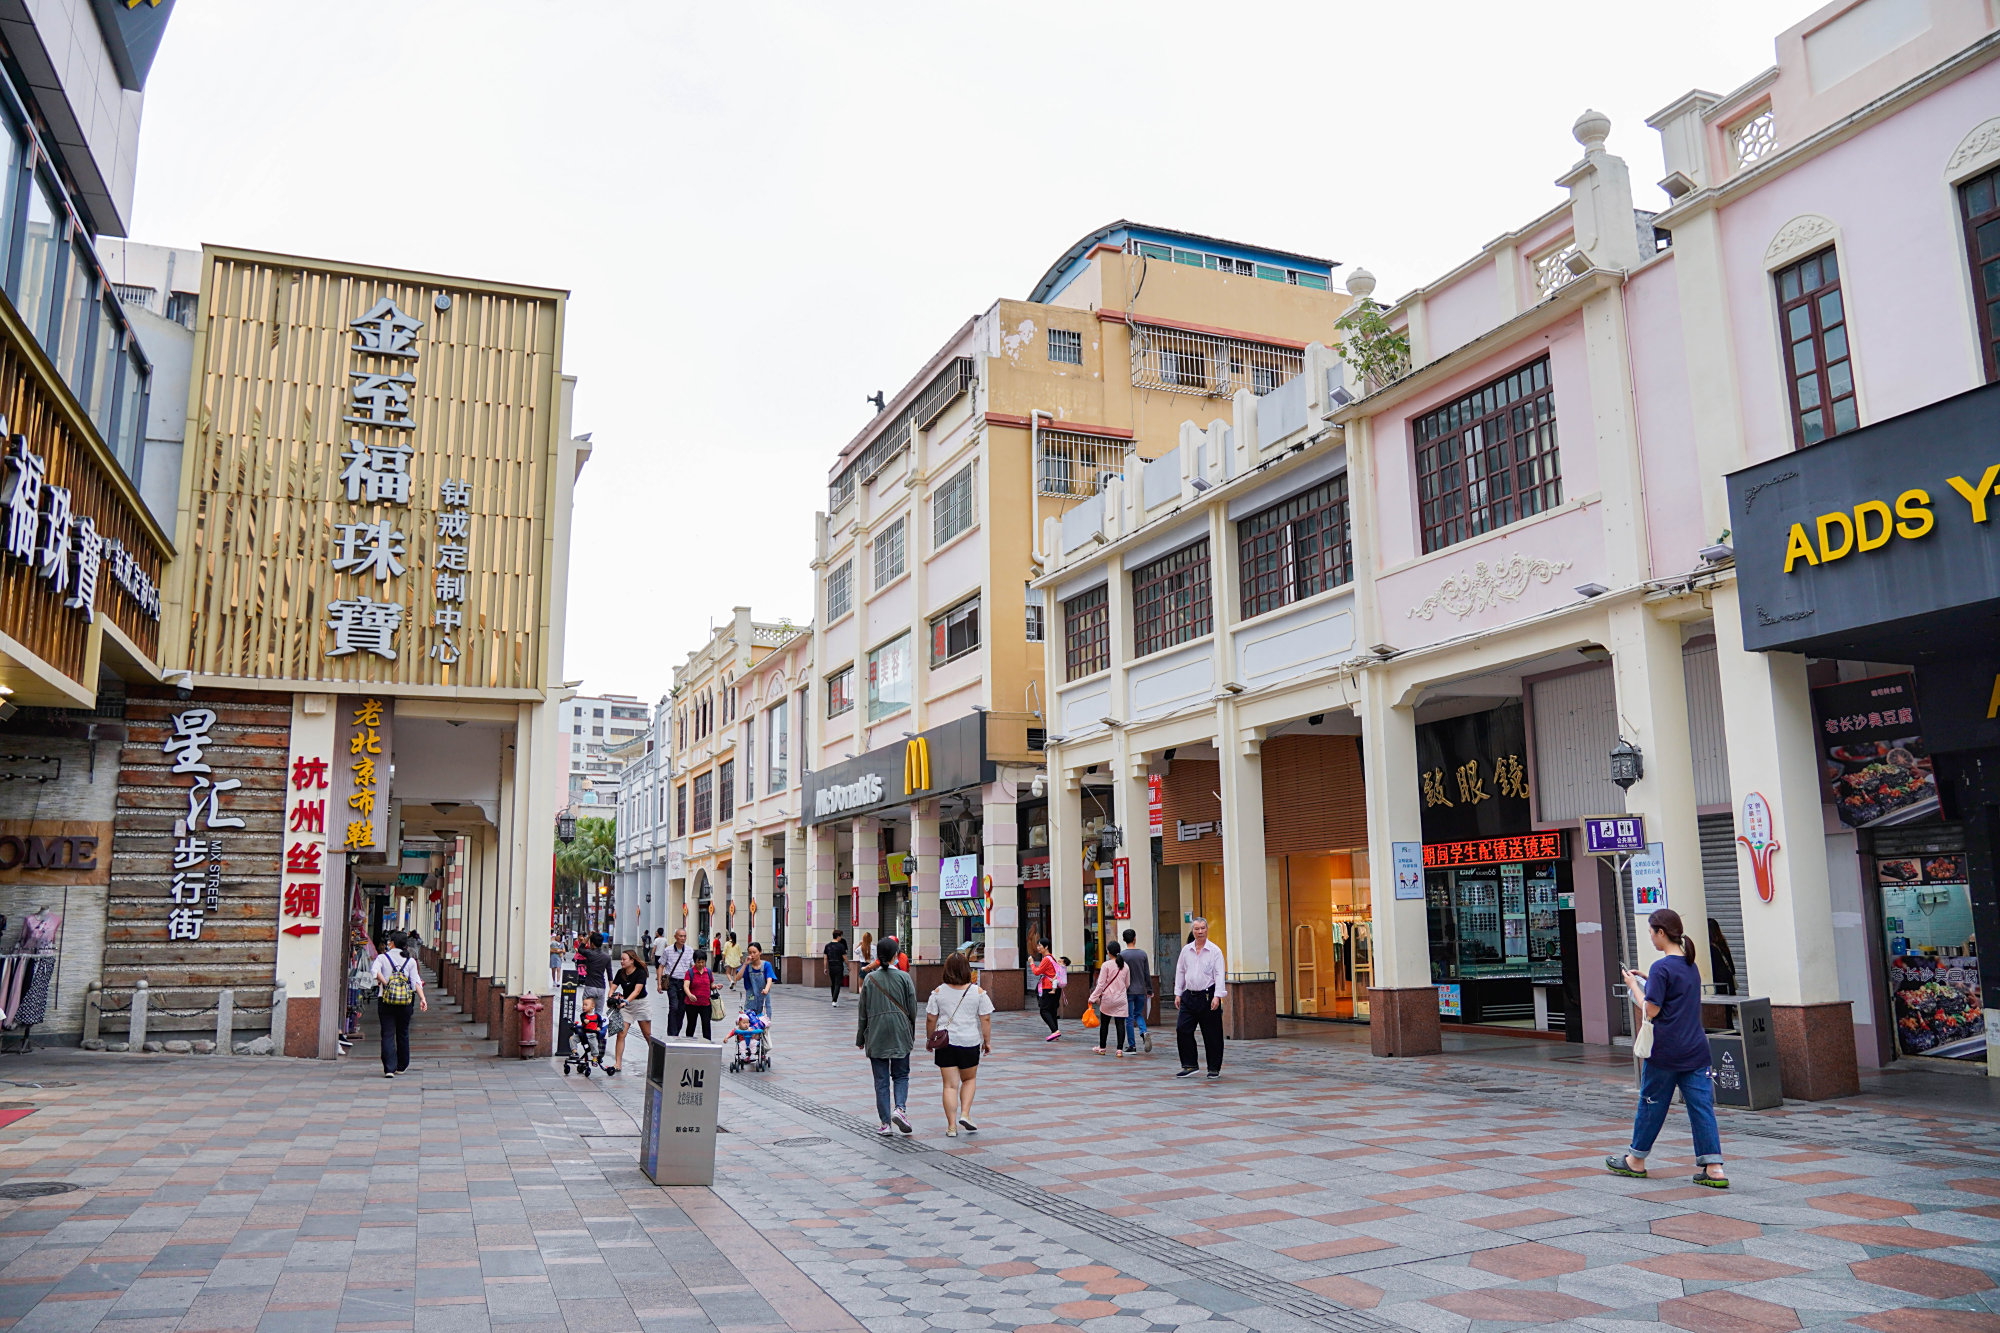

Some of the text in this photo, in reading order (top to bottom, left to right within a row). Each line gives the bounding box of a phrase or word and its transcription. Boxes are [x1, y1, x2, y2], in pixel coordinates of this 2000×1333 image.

[324, 297, 424, 660] 金至福珠寶
[1783, 464, 2000, 573] ADDS Y
[430, 477, 472, 664] 钻戒定制中心
[164, 709, 246, 831] 星汇
[1825, 707, 1913, 734] 老长沙臭豆腐
[344, 698, 384, 850] 老北京布鞋
[815, 773, 884, 818] McDonald's
[0, 836, 98, 870] OME
[168, 838, 209, 941] 步行街
[209, 840, 221, 912] MIX STREET
[284, 756, 328, 918] 杭州丝绸
[1891, 966, 1978, 984] 老长沙臭豆腐
